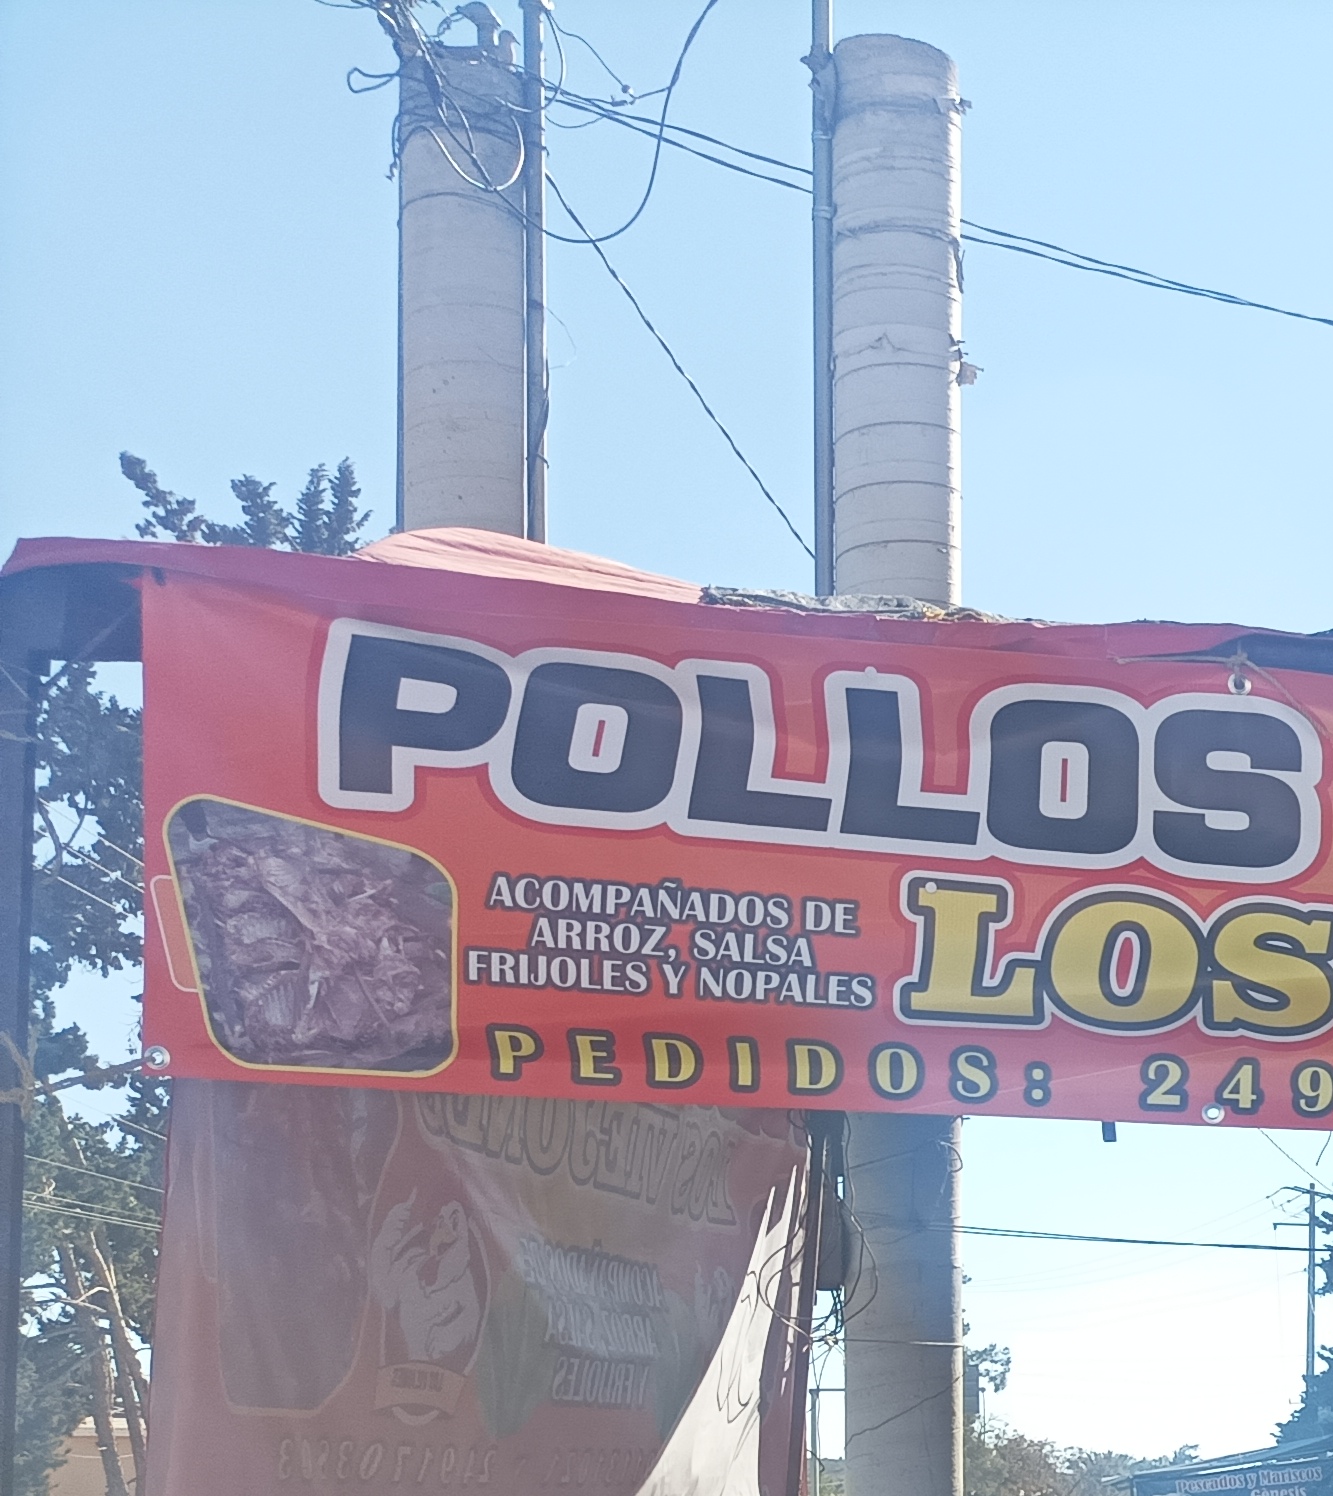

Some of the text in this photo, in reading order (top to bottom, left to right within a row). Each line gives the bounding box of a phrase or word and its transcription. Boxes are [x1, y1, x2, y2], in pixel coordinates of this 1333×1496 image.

[325, 625, 1315, 877] POLLOS
[490, 876, 858, 935] ACOMPAÑADOS DE
[531, 917, 813, 968] ARROZ, SALSA
[468, 950, 874, 1007] FRIJOLES Y NOPALES
[488, 1026, 1050, 1106] PEDIDOS:
[1175, 1474, 1246, 1494] Pescados
[1258, 1466, 1322, 1487] Mariscos
